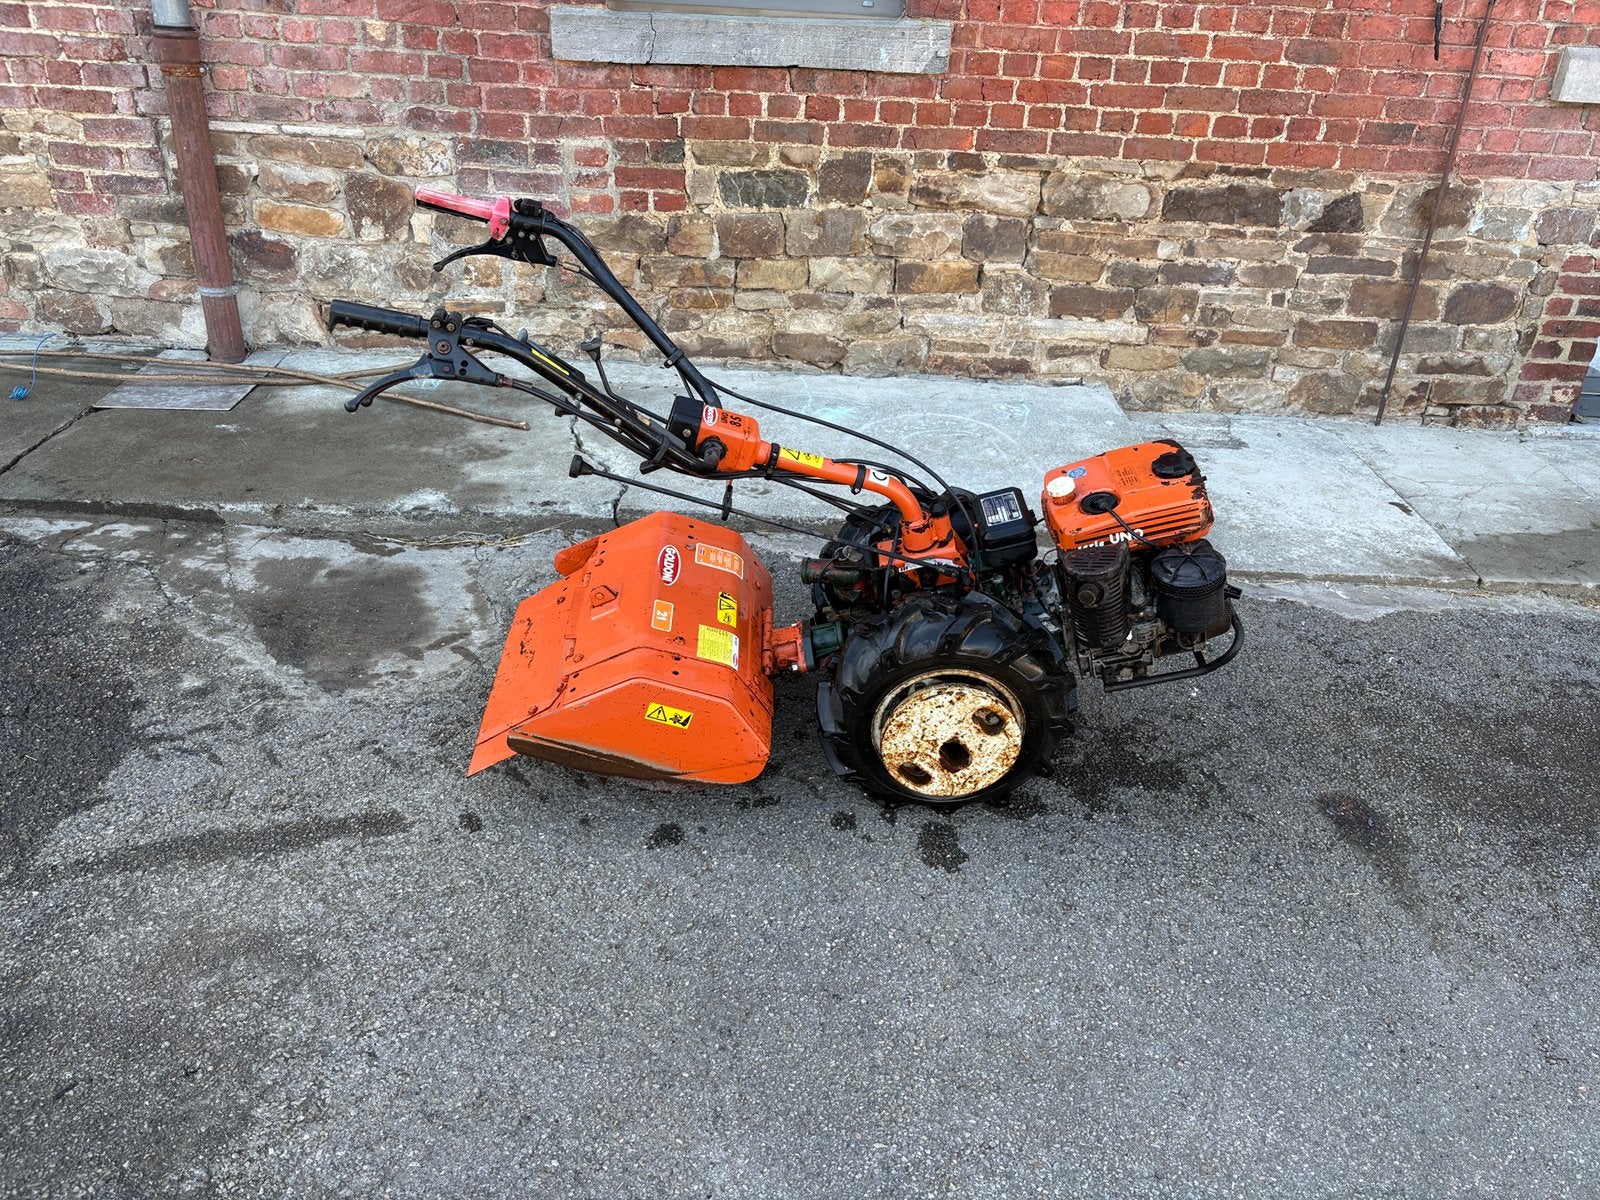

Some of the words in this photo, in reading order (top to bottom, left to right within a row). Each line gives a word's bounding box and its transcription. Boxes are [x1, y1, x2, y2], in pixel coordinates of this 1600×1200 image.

[721, 411, 729, 424] UNO
[729, 415, 742, 428] 85
[1108, 528, 1144, 545] UNO
[662, 547, 676, 583] GOLDONI
[656, 610, 668, 621] 21
